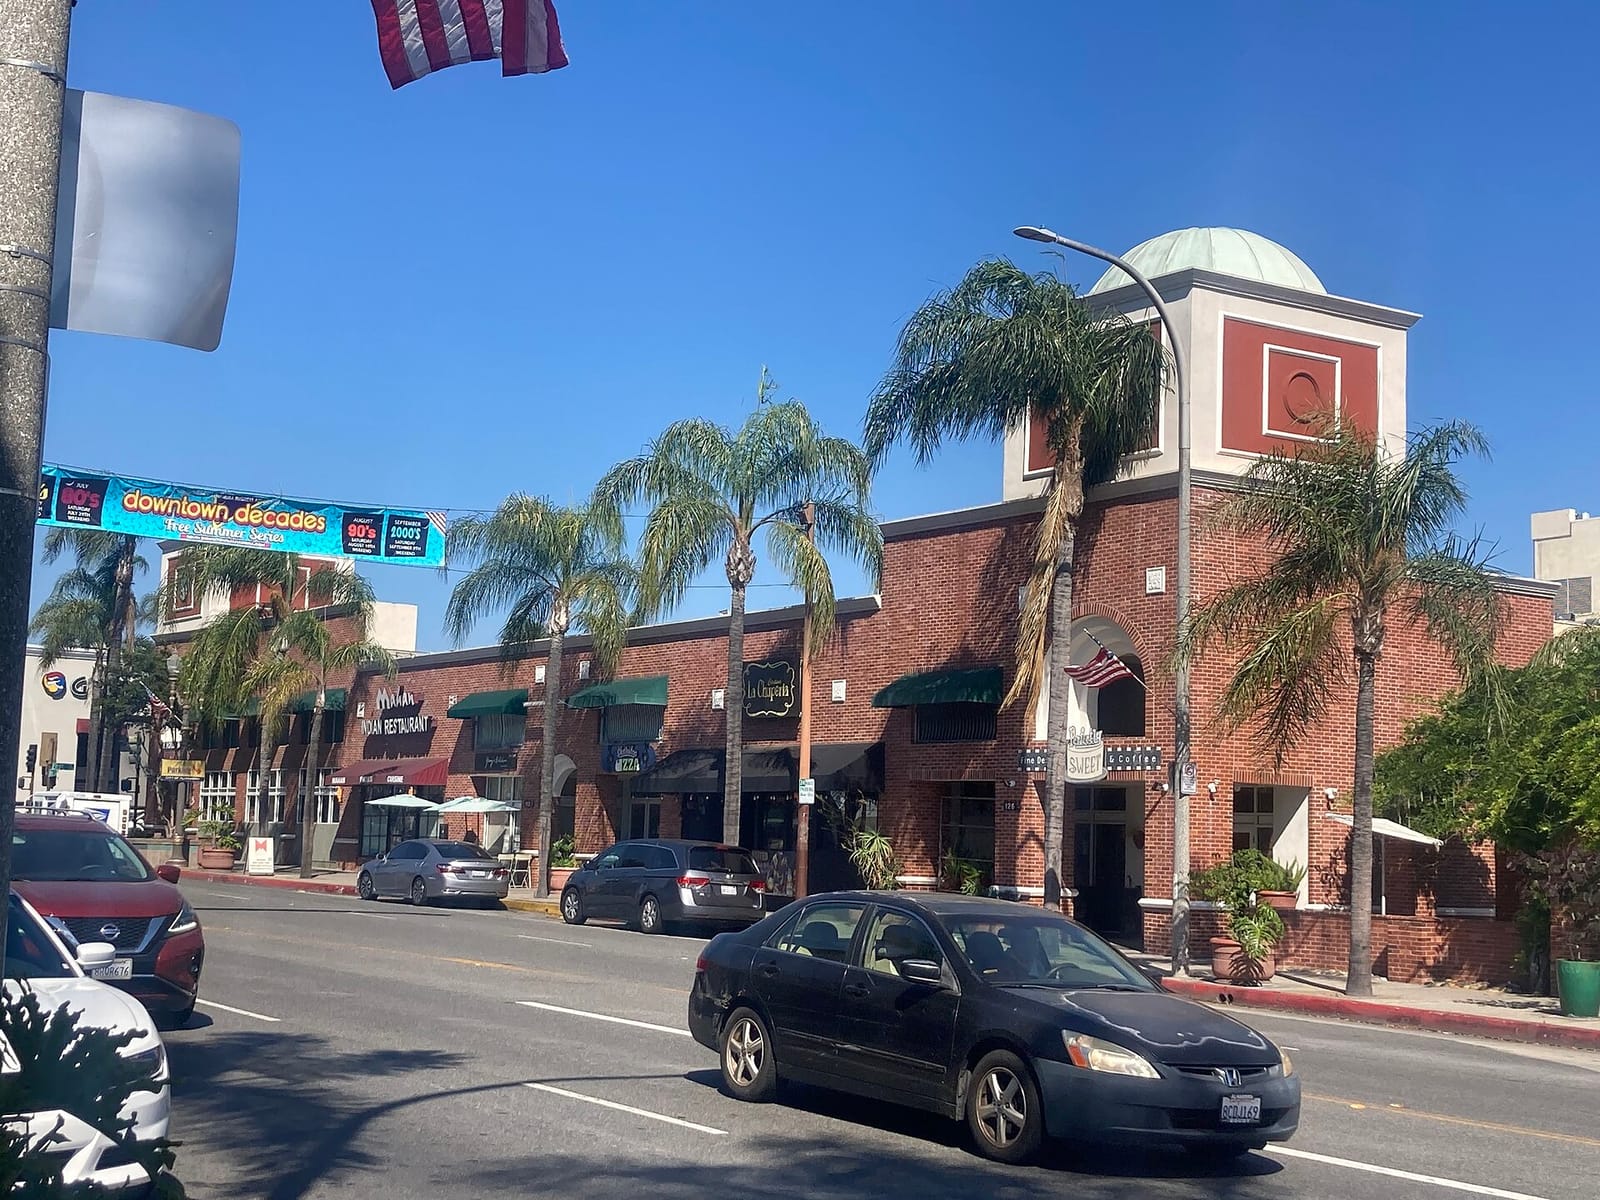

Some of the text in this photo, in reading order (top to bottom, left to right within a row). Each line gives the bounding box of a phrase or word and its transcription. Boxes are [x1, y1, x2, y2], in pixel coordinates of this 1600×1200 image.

[122, 489, 326, 532] downtown decades
[165, 518, 190, 533] Free
[194, 521, 244, 538] Summer
[248, 527, 284, 543] Series
[394, 519, 421, 527] SEPTEMBER
[361, 716, 429, 736] INDIAN RESTAURANT
[1069, 754, 1102, 774] SWEET
[1109, 754, 1115, 764] &
[1118, 754, 1157, 764] Coffee
